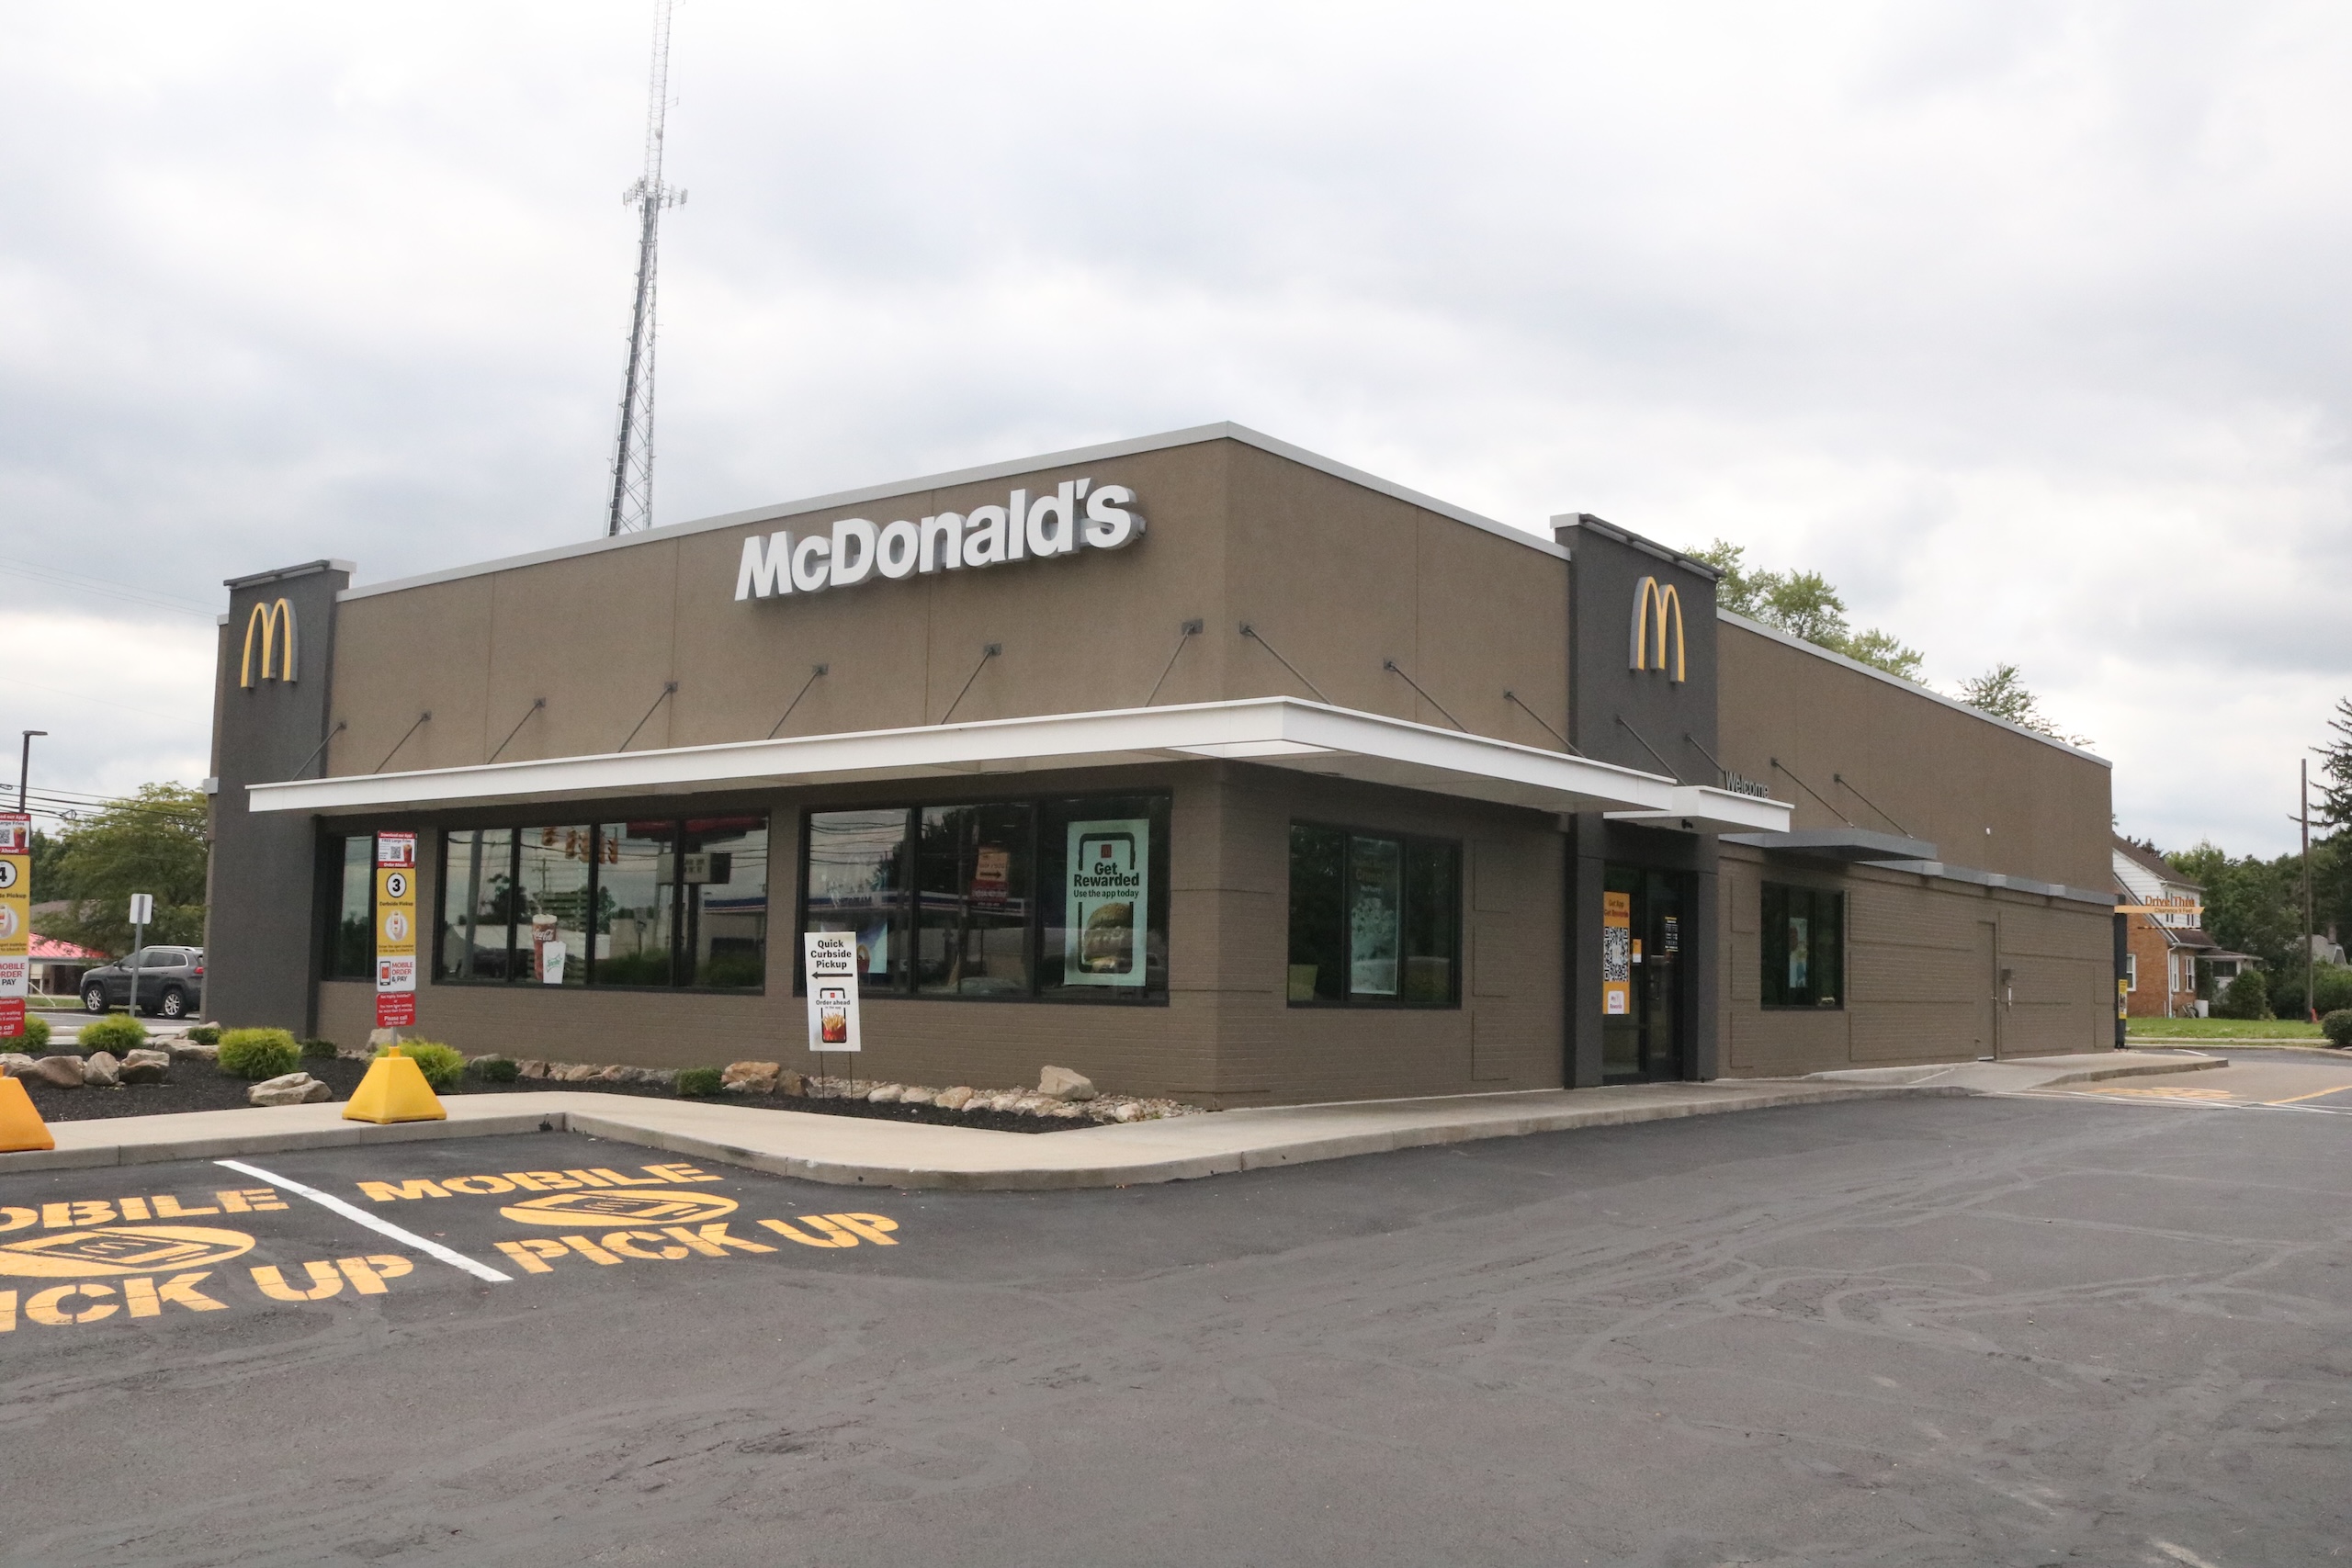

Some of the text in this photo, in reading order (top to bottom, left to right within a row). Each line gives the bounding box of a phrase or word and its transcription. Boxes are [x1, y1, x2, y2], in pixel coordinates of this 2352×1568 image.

[735, 477, 1136, 601] McDonald's
[1724, 771, 1769, 798] Welcome
[1094, 863, 1118, 874] Get
[392, 878, 401, 892] 3
[1074, 873, 1139, 886] Rewarded
[1073, 889, 1139, 899] Use the app today
[2145, 896, 2195, 907] Drive Thru
[818, 939, 844, 949] Quick
[810, 950, 852, 958] Curbside
[816, 960, 847, 970] Pickup
[356, 1163, 724, 1201] MOBILE
[493, 1213, 900, 1274] PICK UP
[250, 1254, 413, 1301] UP
